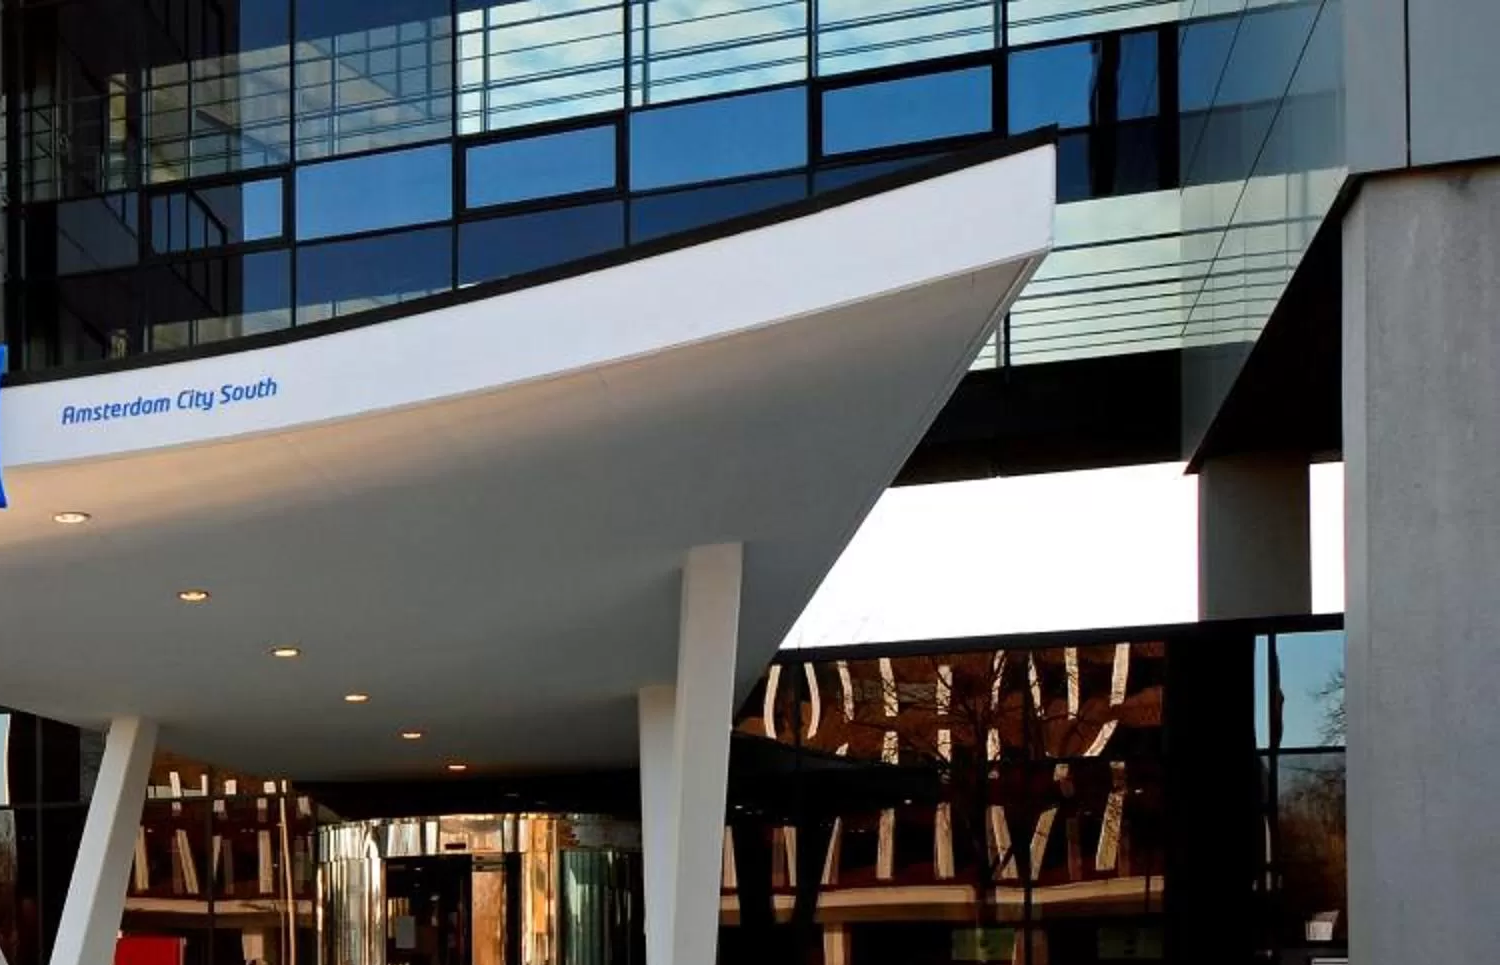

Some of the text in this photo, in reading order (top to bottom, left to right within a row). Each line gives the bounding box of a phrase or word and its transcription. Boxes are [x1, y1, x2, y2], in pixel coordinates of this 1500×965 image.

[62, 377, 278, 425] Amsterdam City South
